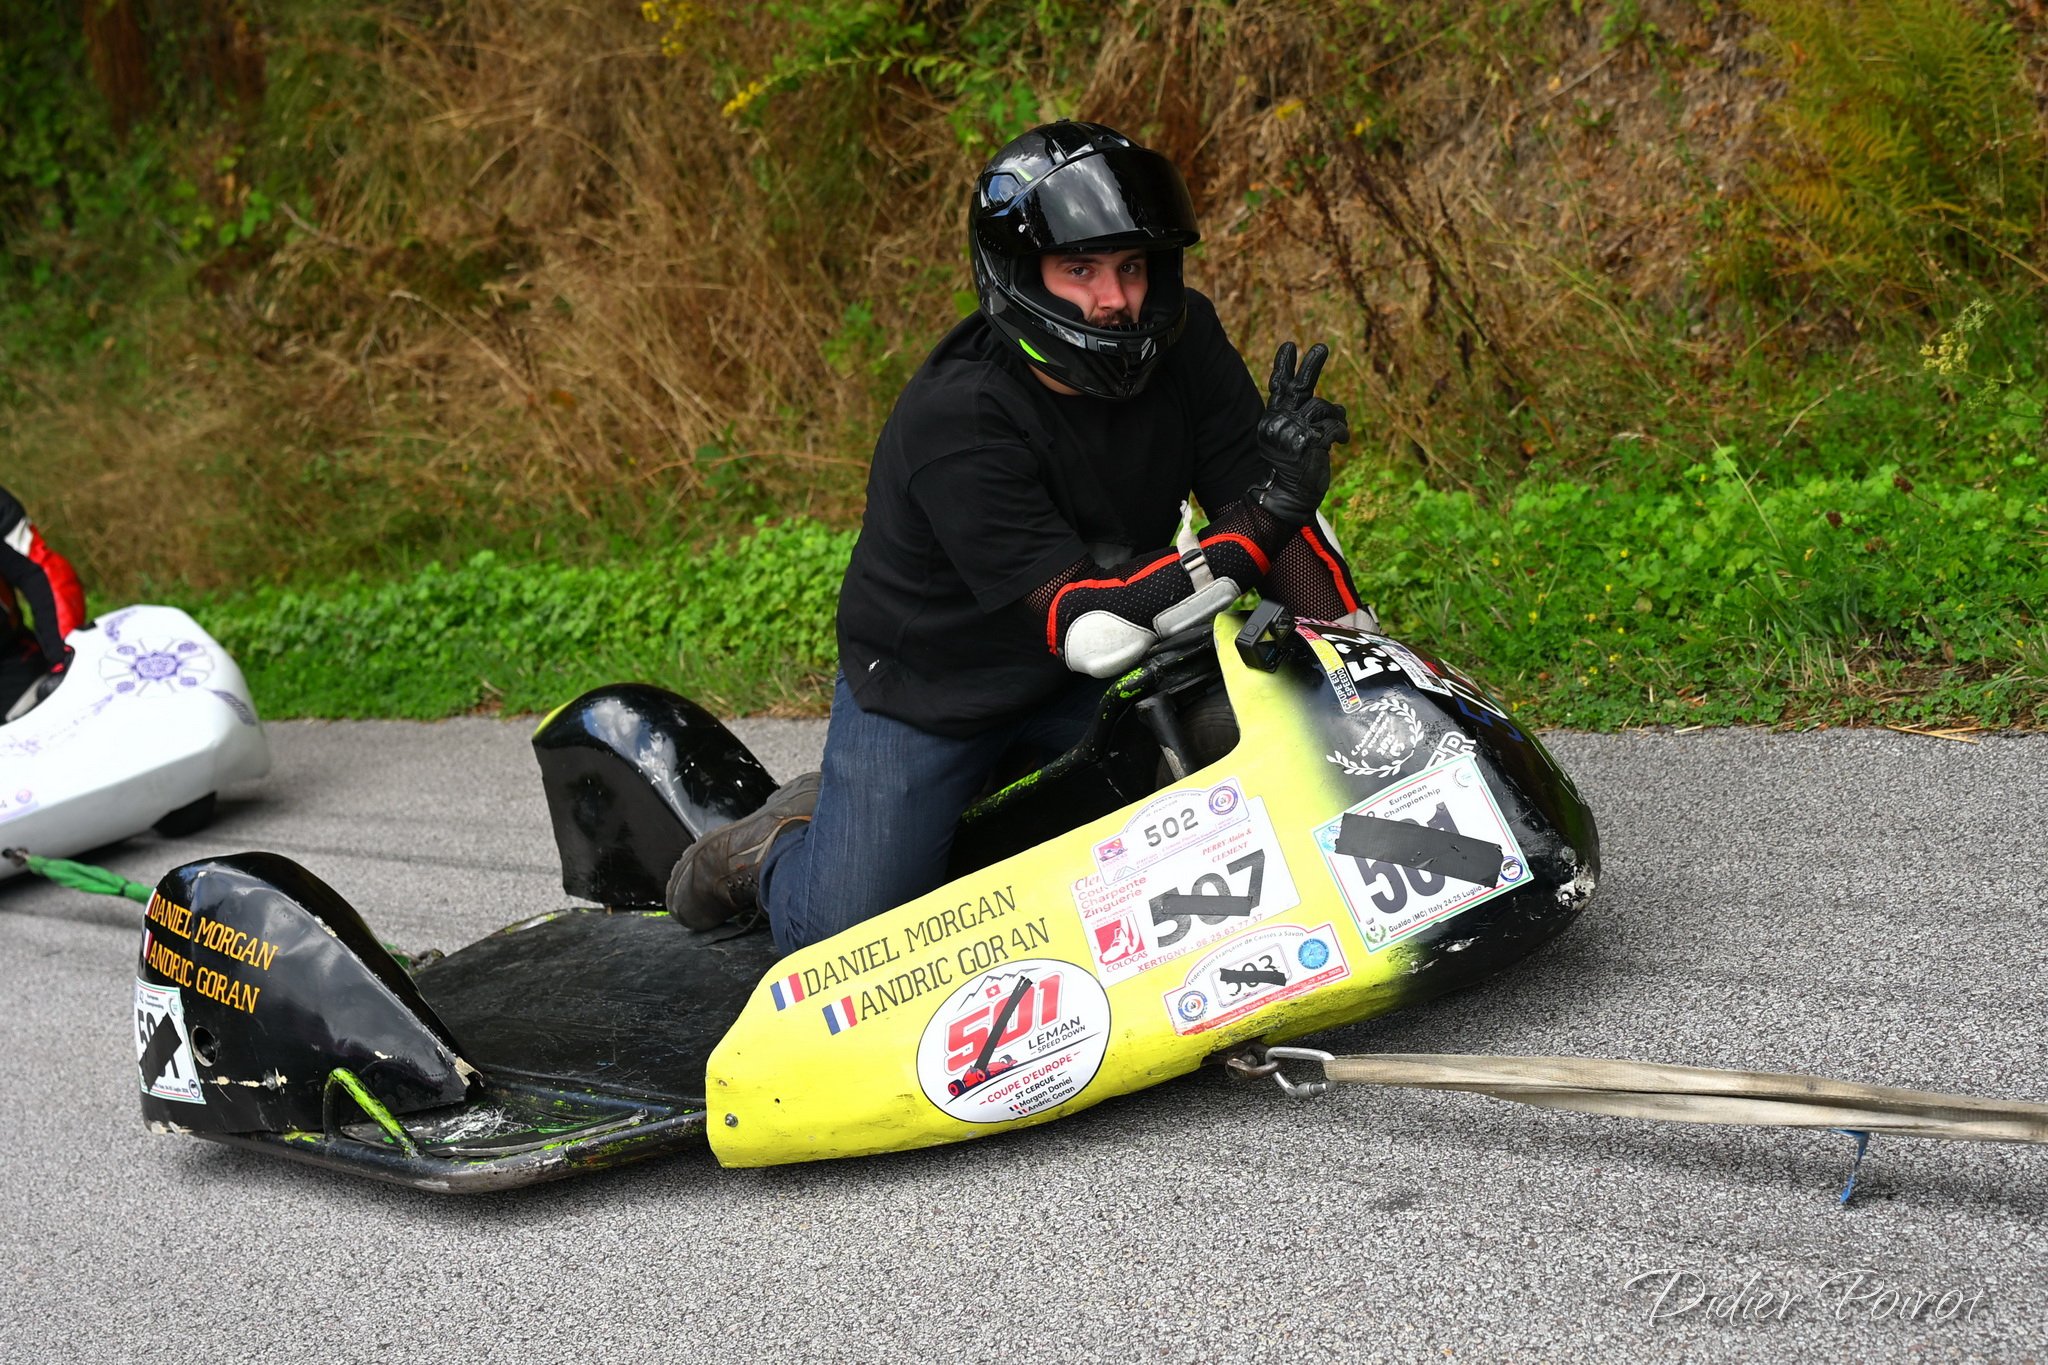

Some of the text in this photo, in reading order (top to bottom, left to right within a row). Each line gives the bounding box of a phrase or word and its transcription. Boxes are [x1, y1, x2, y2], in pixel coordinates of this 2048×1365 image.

[1383, 787, 1442, 819] Championship
[1388, 783, 1428, 807] European
[1144, 807, 1200, 848] 502
[1211, 841, 1249, 863] CLEMENT
[1080, 876, 1147, 911] Charpente
[1083, 887, 1143, 919] Zinguerie
[1388, 884, 1483, 933] Gualdo (MC) Italy 24-25 Luglio
[150, 895, 279, 971] DANIEL MORGAN
[803, 885, 1017, 998] DANIEL MORGAN
[1283, 930, 1304, 938] Savon
[861, 917, 1051, 1021] ANDRIC GORAN
[1106, 951, 1149, 974] COLOCAS
[1137, 945, 1188, 973] XERTIGNY
[150, 942, 261, 1014] ANDRIC GORAN
[948, 974, 1060, 1072] 501
[1028, 1016, 1081, 1050] LEMAN
[1037, 1024, 1086, 1053] SPEED DOWN
[987, 1054, 1073, 1103] COUPE D'EUROPE
[1015, 1075, 1055, 1100] ST CERGUE
[1019, 1076, 1073, 1108] Morgan Daniel
[1027, 1085, 1076, 1113] Andric Goran
